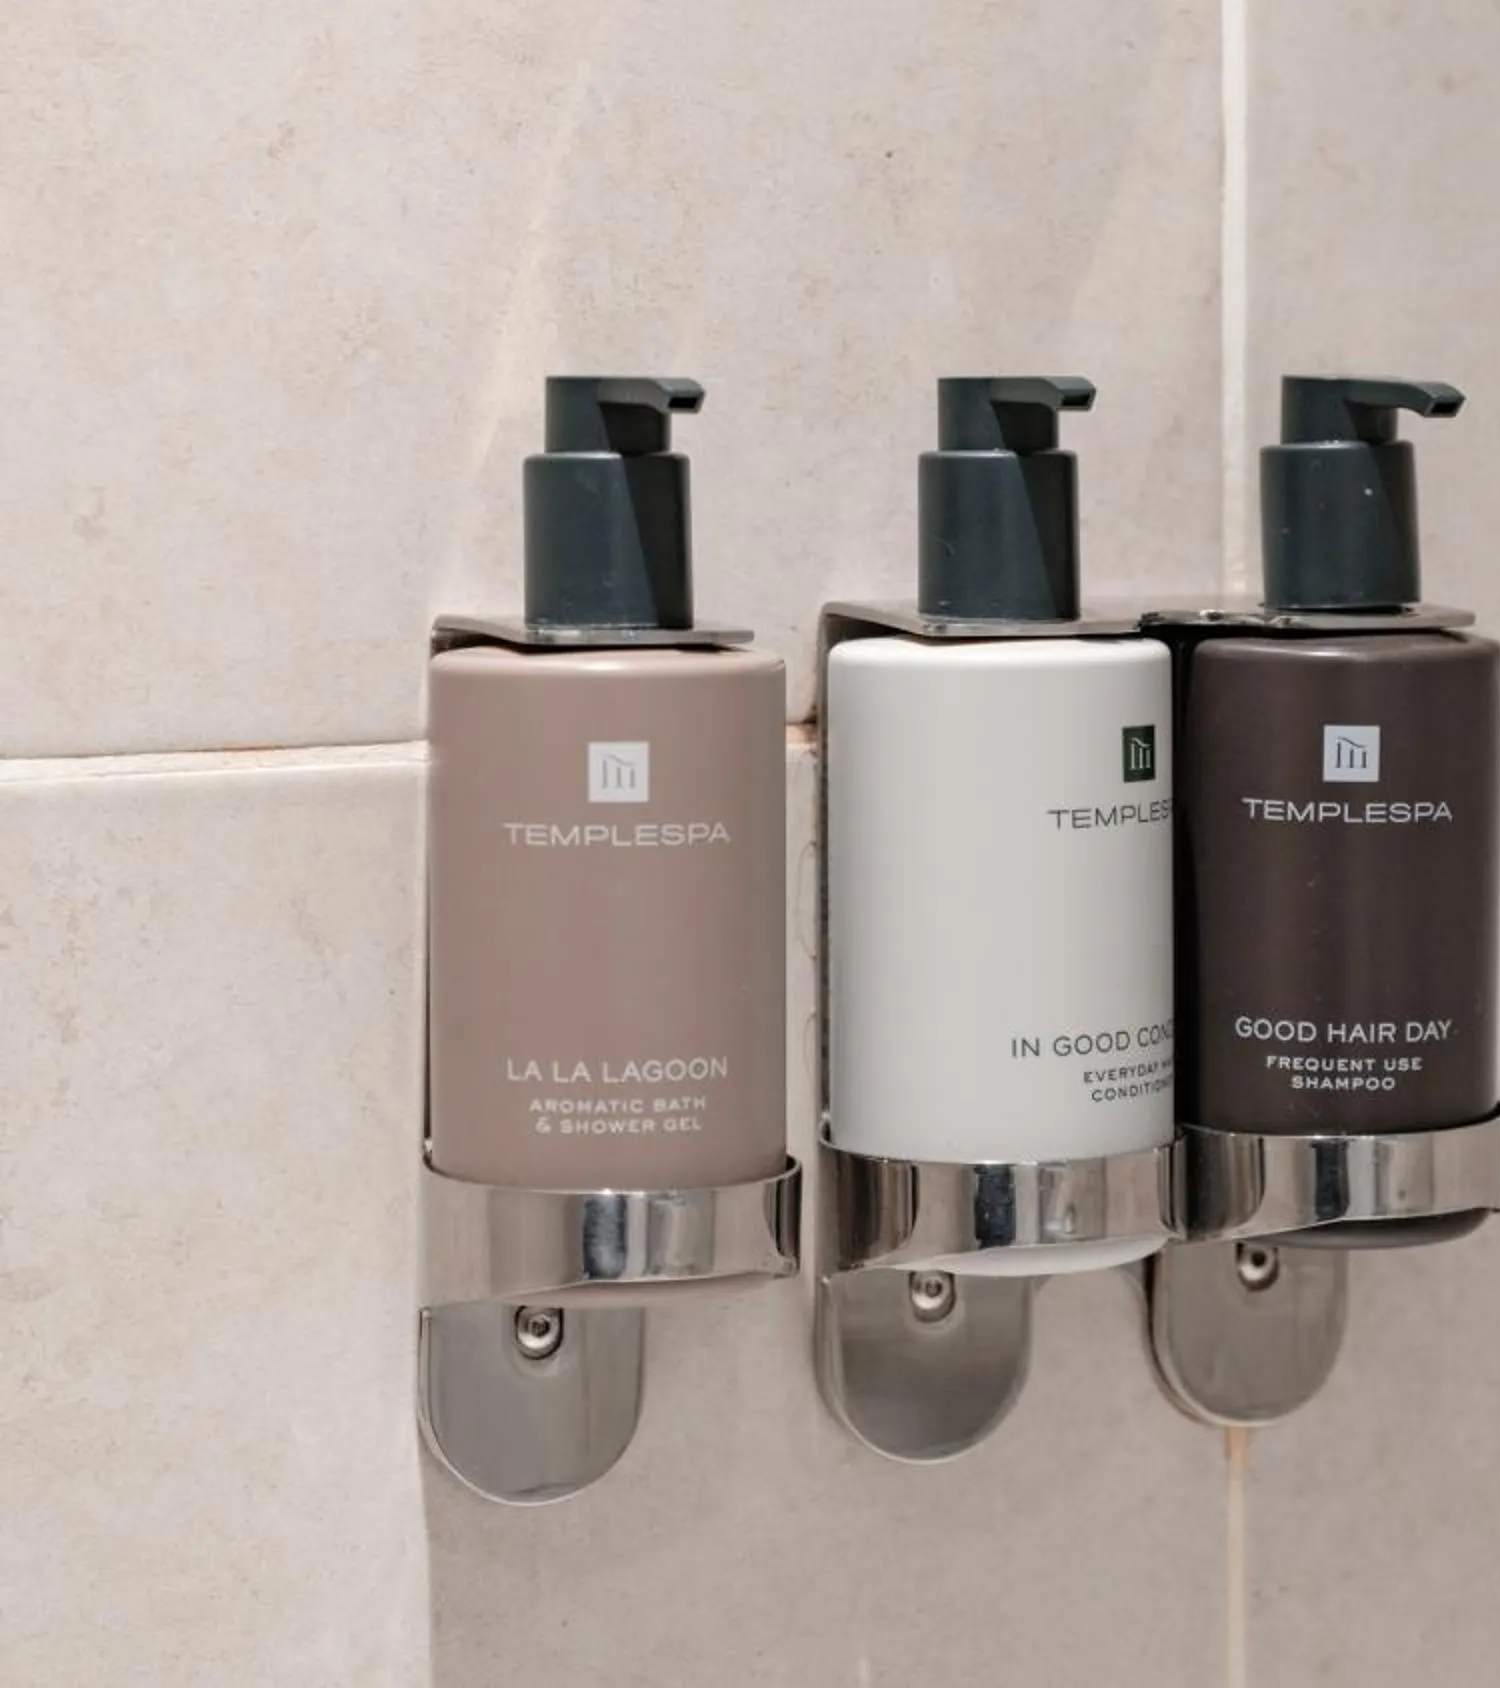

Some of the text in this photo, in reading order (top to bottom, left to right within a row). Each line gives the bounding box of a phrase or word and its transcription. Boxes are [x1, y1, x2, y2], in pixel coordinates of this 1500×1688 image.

[1046, 799, 1171, 830] TEMPLES
[1241, 797, 1453, 824] TEMPLESPA
[503, 822, 731, 846] TEMPLESPA
[1011, 1019, 1173, 1058] IN GOOD CON
[1234, 1016, 1452, 1043] GOOD HAIR DAY
[507, 1056, 728, 1083] LA LA LAGOON
[1083, 1061, 1159, 1083] EVERYDAY
[1266, 1055, 1423, 1072] FREQUENT USE
[1291, 1075, 1396, 1091] SHAMPOO
[529, 1096, 706, 1114] AROMATIC BATH
[535, 1116, 703, 1134] & SHOWER GEL
